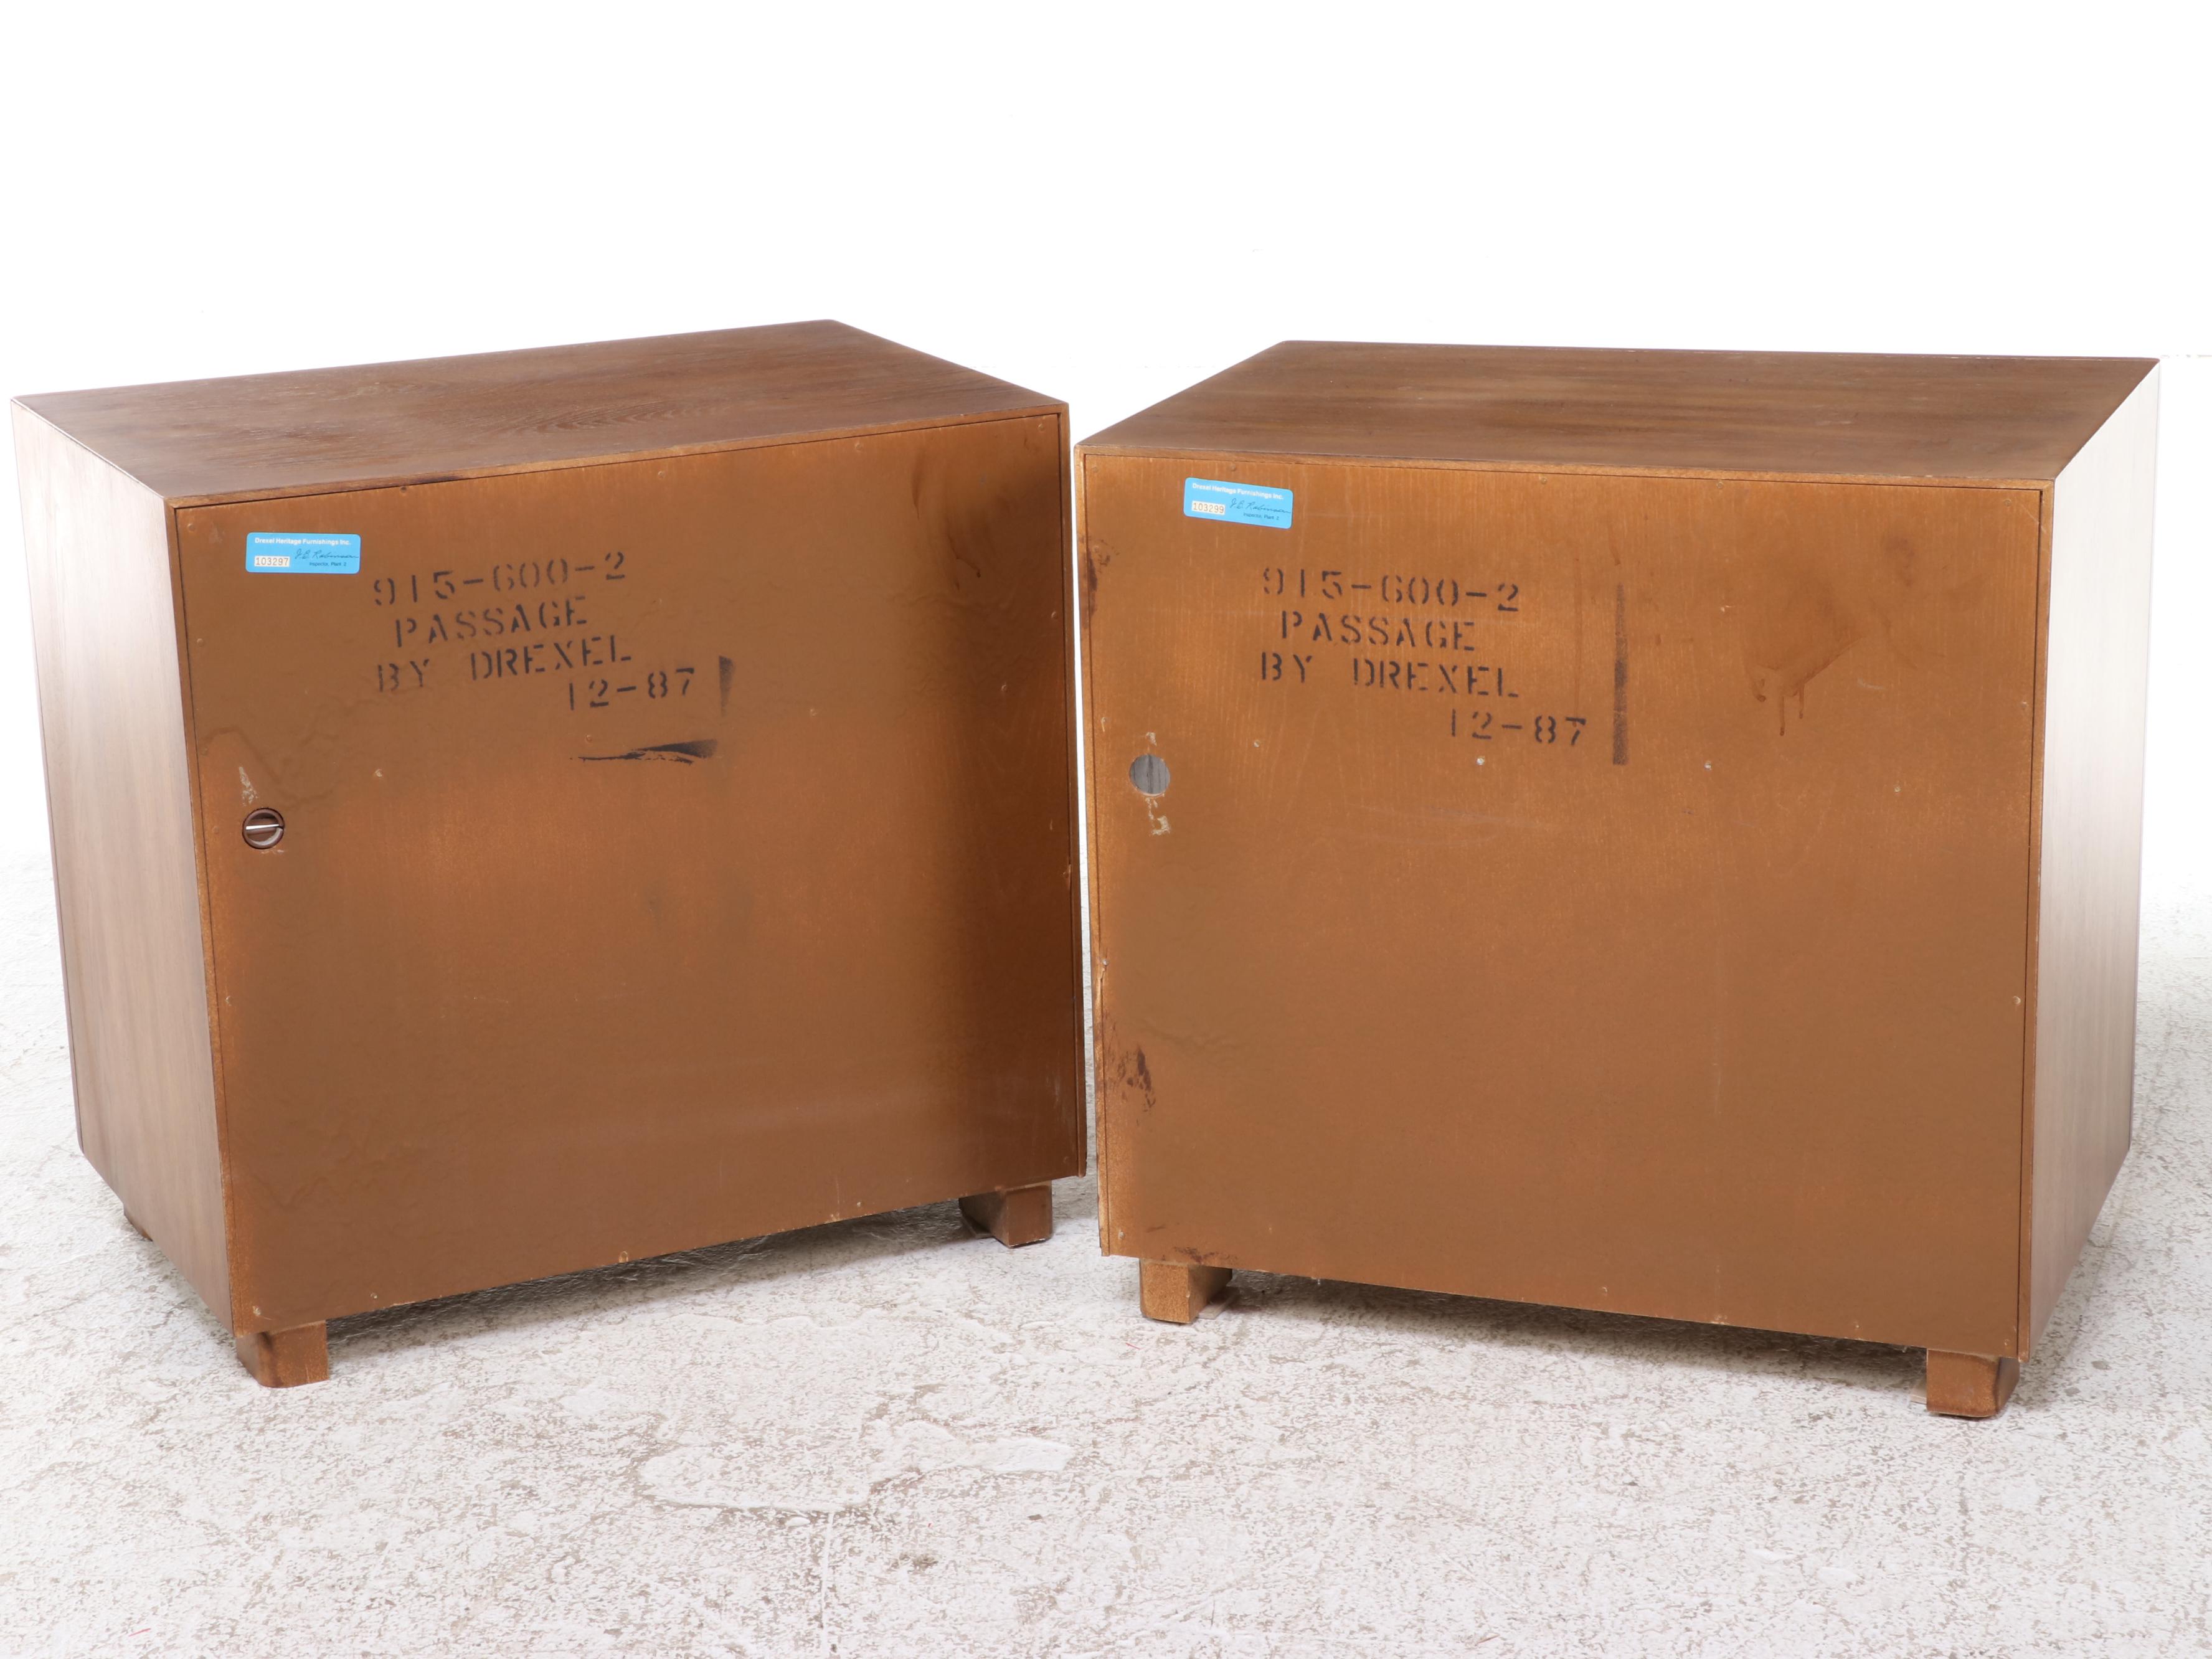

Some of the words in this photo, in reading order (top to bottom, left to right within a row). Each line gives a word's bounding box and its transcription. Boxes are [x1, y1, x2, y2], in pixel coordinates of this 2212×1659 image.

[1193, 503, 1224, 513] 103299
[1212, 485, 1236, 494] Heritage
[1237, 488, 1272, 499] Furnishings
[255, 557, 289, 566] 103297
[374, 551, 626, 606] 915-600-2
[1263, 567, 1519, 612] 915-600-2
[395, 595, 587, 648] PASSAGE
[1282, 610, 1475, 651] PASSAGE
[377, 658, 430, 692] BY
[471, 635, 631, 681] DREXEL
[1261, 652, 1312, 683] BY
[1354, 658, 1519, 697] DREXEL
[569, 667, 694, 711] 12-87
[1451, 709, 1586, 745] 12-87
